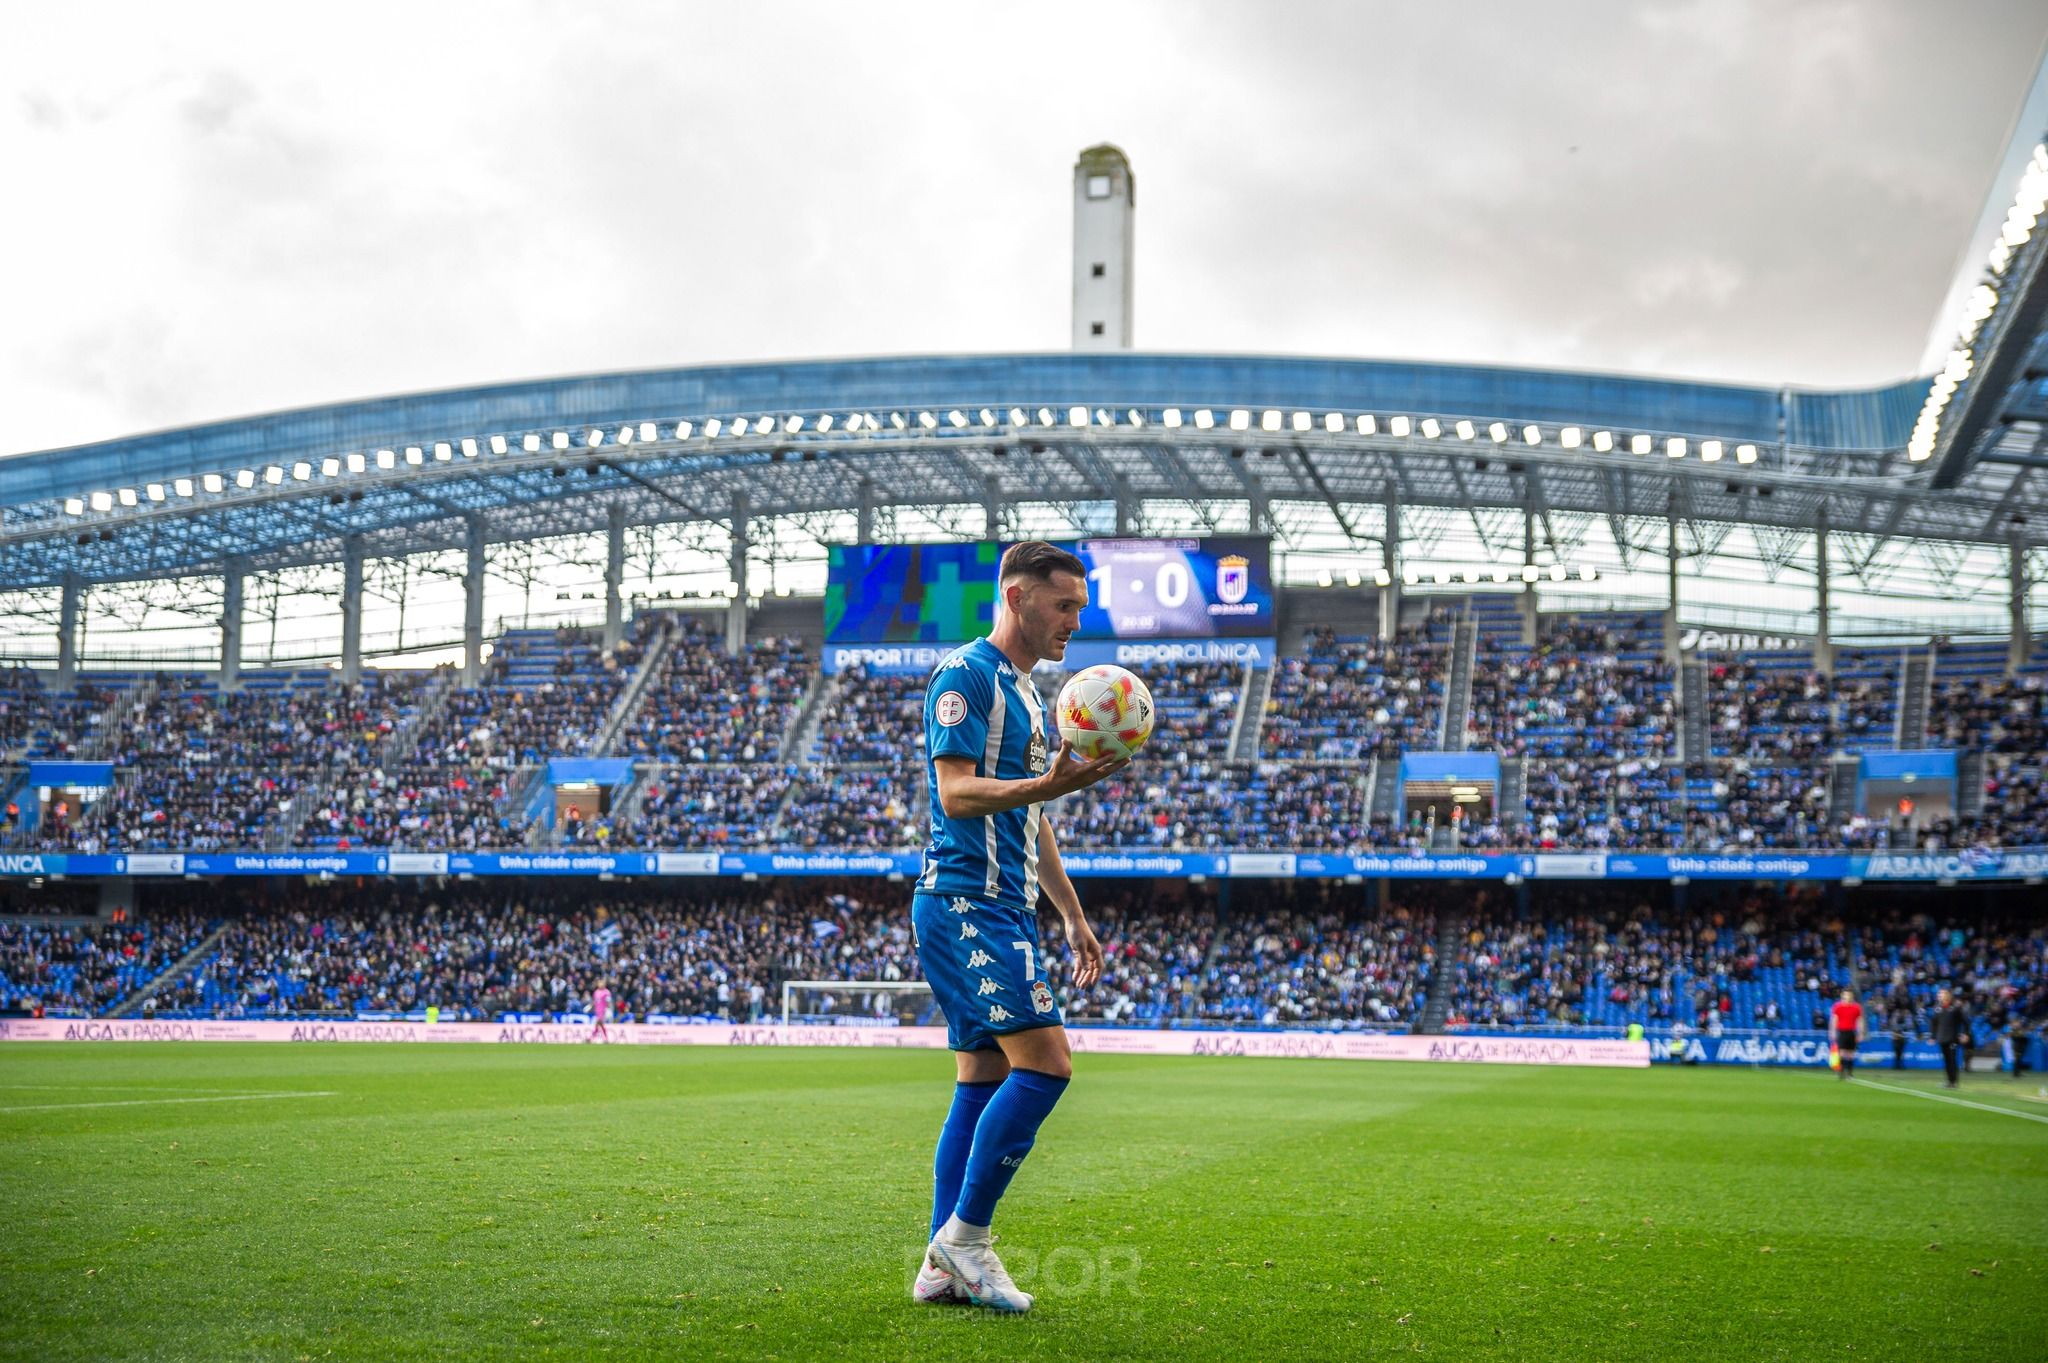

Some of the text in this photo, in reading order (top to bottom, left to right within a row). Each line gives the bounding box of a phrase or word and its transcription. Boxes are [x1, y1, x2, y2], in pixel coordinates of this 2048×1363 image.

[1089, 562, 1189, 609] 1 0
[1012, 941, 1035, 981] 7
